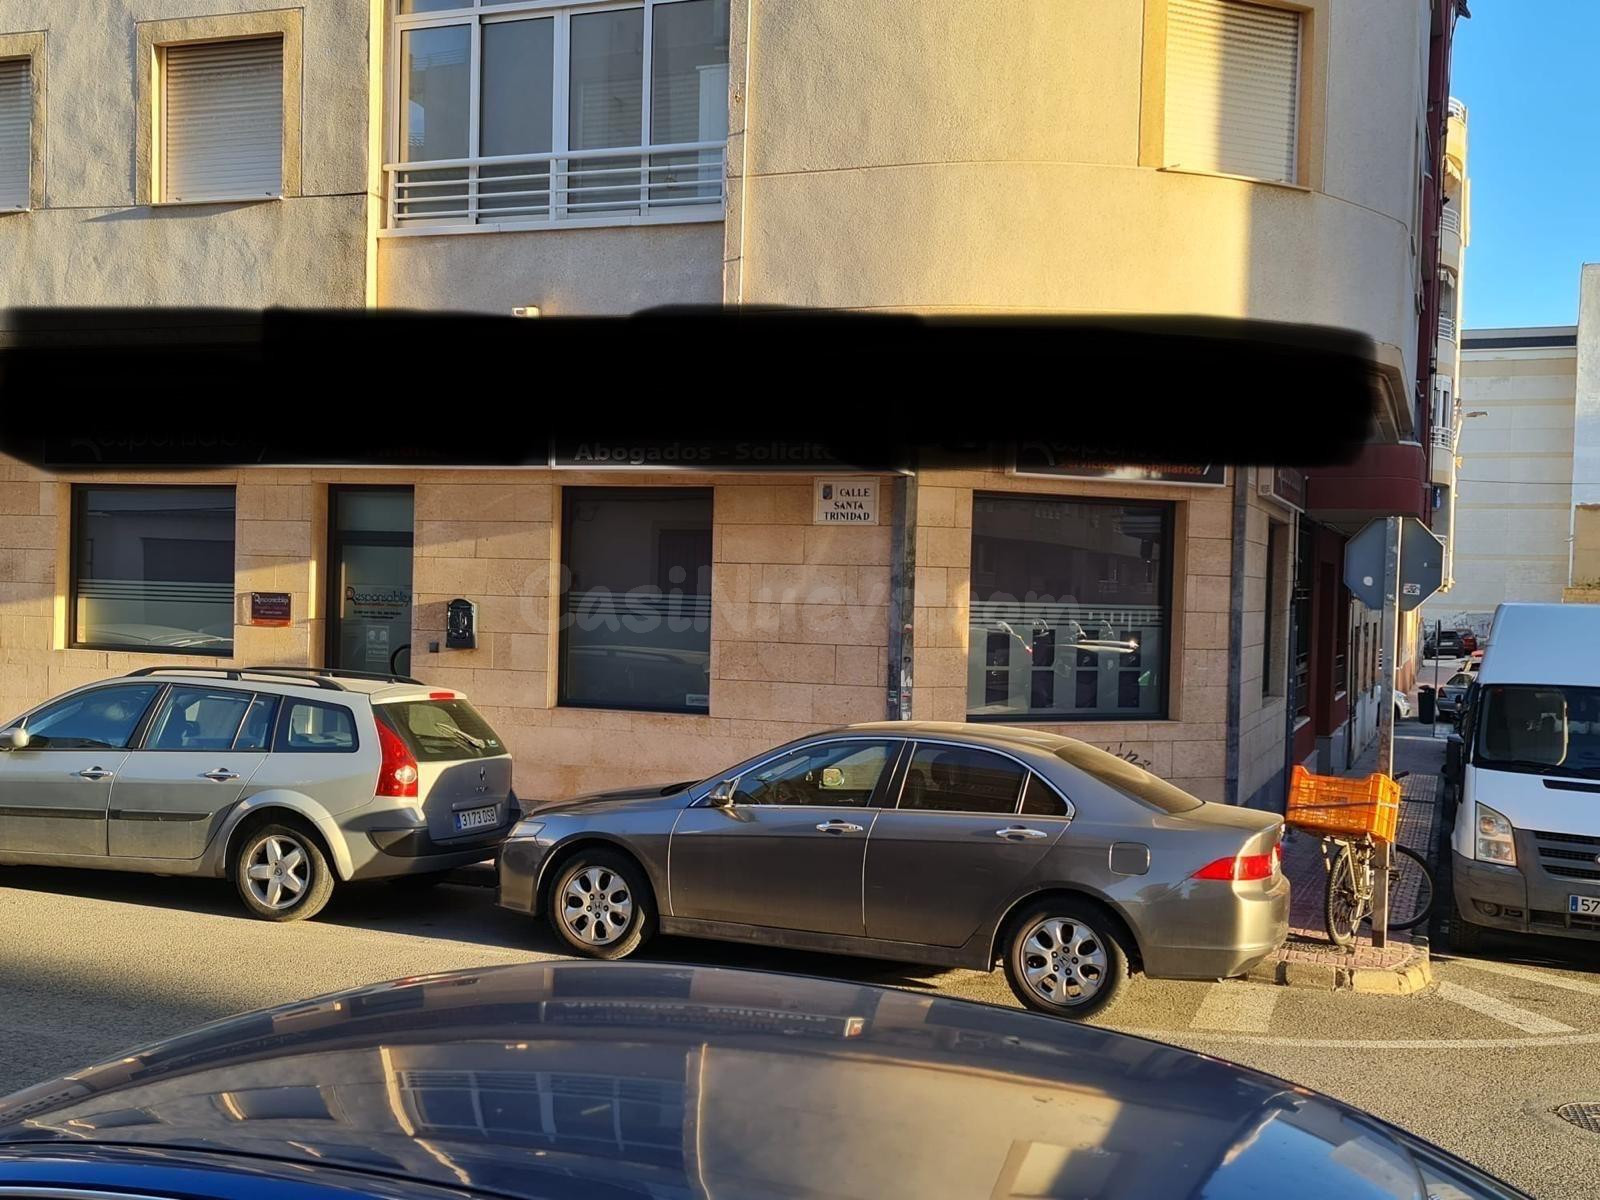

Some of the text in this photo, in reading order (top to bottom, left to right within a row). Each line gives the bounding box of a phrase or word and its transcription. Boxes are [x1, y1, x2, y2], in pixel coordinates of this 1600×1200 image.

[575, 442, 712, 465] Abogados
[840, 487, 871, 498] CALLE
[833, 500, 864, 511] SANTA
[823, 511, 871, 521] TRINIDAD
[1581, 898, 1600, 912] 57
